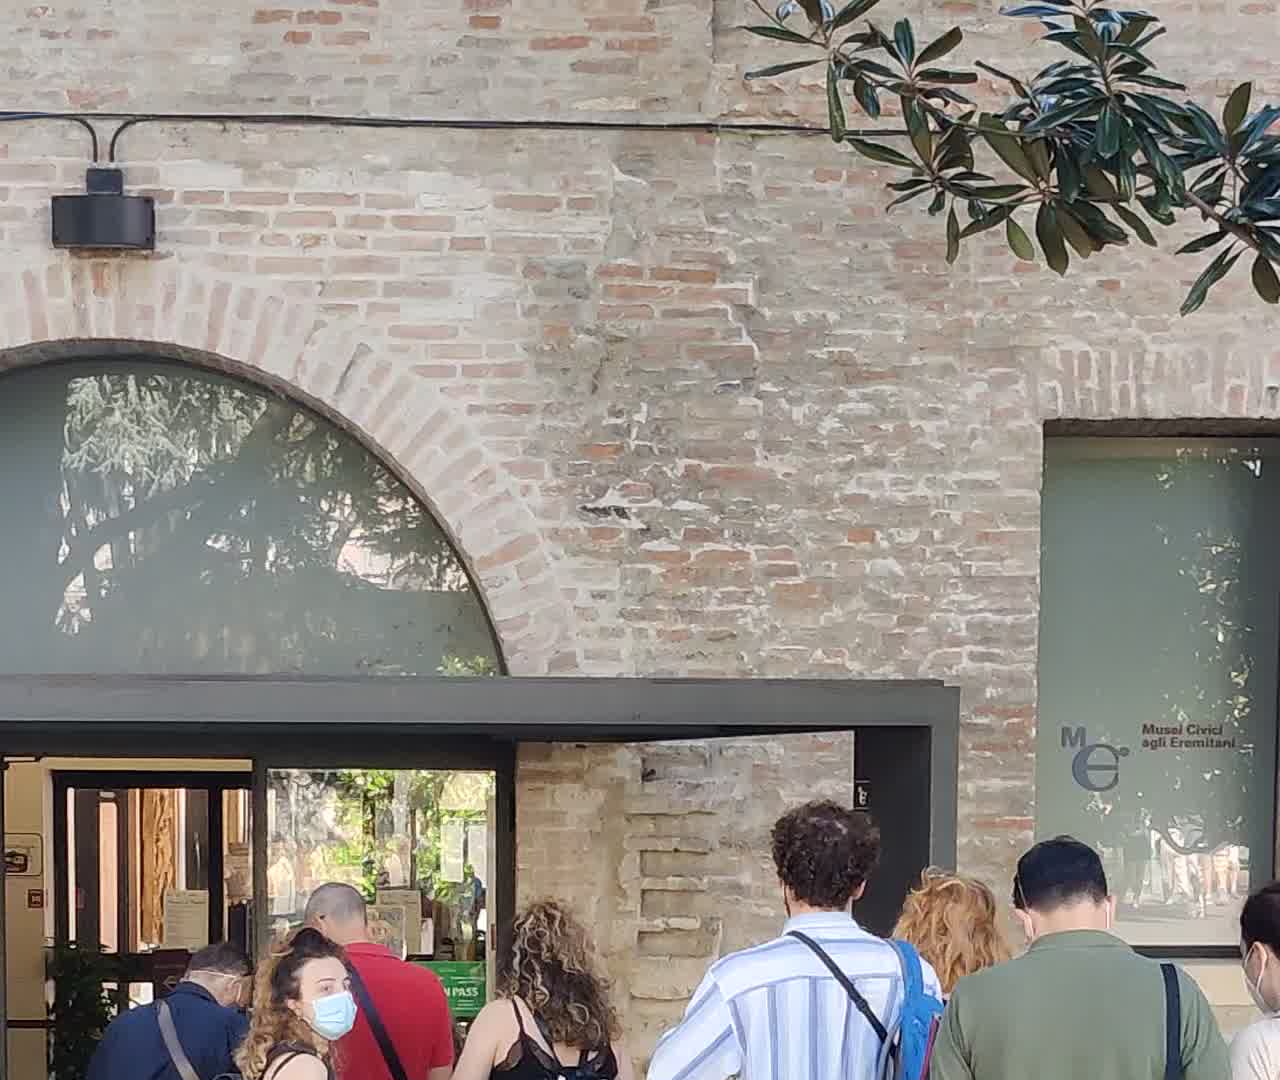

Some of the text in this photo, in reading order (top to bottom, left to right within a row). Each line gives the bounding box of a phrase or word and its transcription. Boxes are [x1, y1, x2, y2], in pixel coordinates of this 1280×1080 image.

[1142, 723, 1223, 736] Musei Civici
[1142, 736, 1236, 750] agli Eremitani
[451, 986, 480, 998] PASS
